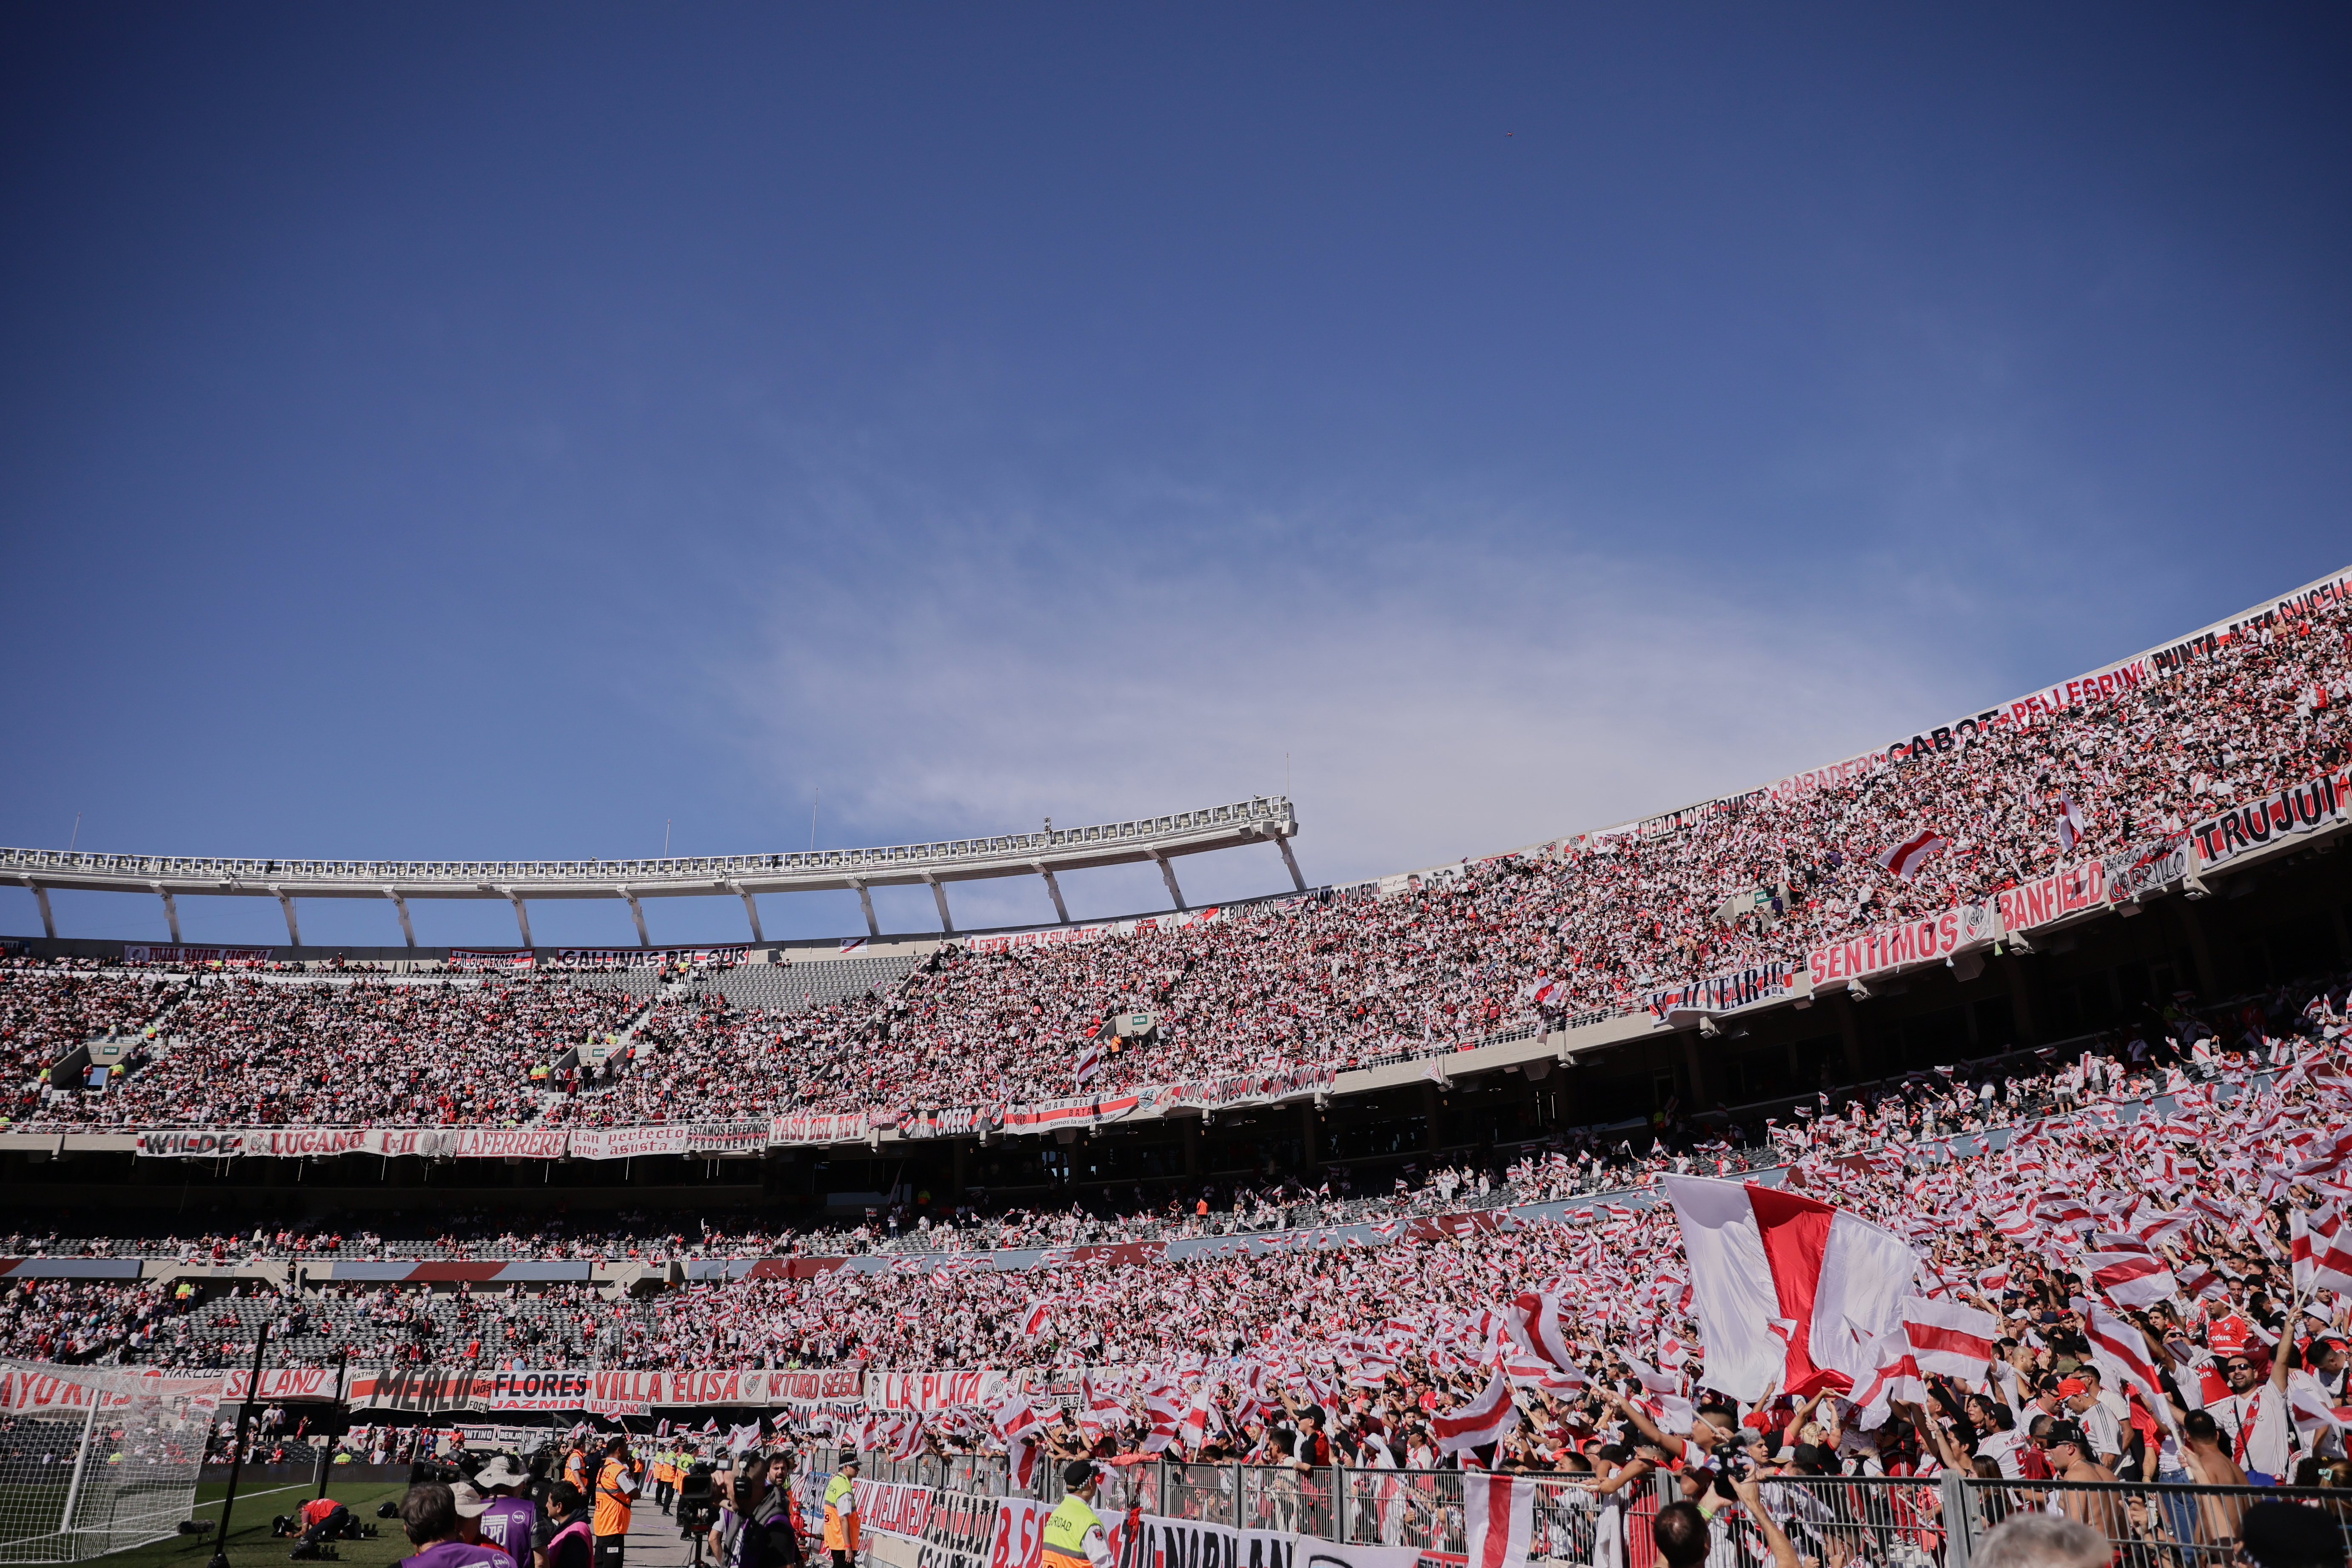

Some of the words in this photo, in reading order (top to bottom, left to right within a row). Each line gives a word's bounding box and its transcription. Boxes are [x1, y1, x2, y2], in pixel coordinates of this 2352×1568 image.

[2152, 631, 2218, 671] PUNTA
[1680, 800, 1717, 825] NORTE
[2195, 776, 2336, 861] TRUJUI
[2106, 847, 2141, 871] BARRIO
[2111, 850, 2186, 898] CARRILLO
[1756, 892, 1767, 900] SALI
[2000, 861, 2103, 931] BANFIELD
[965, 938, 975, 951] LA
[1014, 934, 1036, 946] ALTA
[1041, 932, 1048, 944] Y
[1050, 931, 1063, 943] SU
[1810, 913, 1958, 984] SENTIMOS
[149, 947, 179, 961] FILIAL
[185, 948, 220, 963] RAFAEL
[225, 949, 267, 965] CASTLO
[562, 950, 659, 967] GALLINAS
[666, 949, 699, 966] DEL
[707, 947, 747, 963] SUR
[1675, 968, 1759, 1010] ALVEAR
[1142, 1091, 1153, 1099] 44
[1180, 1082, 1204, 1103] LOS
[1246, 1074, 1264, 1097] DE
[1044, 1100, 1065, 1111] MAR
[1073, 1098, 1088, 1106] DEL
[1098, 1092, 1126, 1102] PLATA
[688, 1124, 725, 1136] ESTAMOS
[728, 1122, 768, 1135] ENFERMOS
[774, 1118, 805, 1141] PASO
[809, 1117, 832, 1140] DEL
[836, 1114, 862, 1140] REY
[936, 1107, 972, 1136] CREER
[1092, 1113, 1117, 1124] popular
[145, 1133, 236, 1155] WILDE
[270, 1130, 365, 1155] LUGANO
[457, 1131, 567, 1156] LAFERRERE
[574, 1130, 599, 1144] tan
[608, 1127, 684, 1146] perfecto
[574, 1143, 599, 1156] que
[352, 1369, 382, 1380] MATHEO
[495, 1374, 587, 1397] FLORES
[370, 1370, 478, 1411] MERLO
[473, 1383, 492, 1394] VOS
[596, 1372, 662, 1403] VILLA
[673, 1372, 738, 1402] ELISA
[768, 1373, 819, 1399] ARTURO
[886, 1374, 912, 1410] LA
[921, 1372, 984, 1411] PLATA
[469, 1400, 487, 1412] FOCO
[491, 1400, 585, 1409] JAZMIN
[464, 1429, 493, 1439] ANTINO
[499, 1431, 536, 1440] BENJAIN
[2012, 1434, 2024, 1445] BORJA
[1046, 1515, 1072, 1532] GURIDAD
